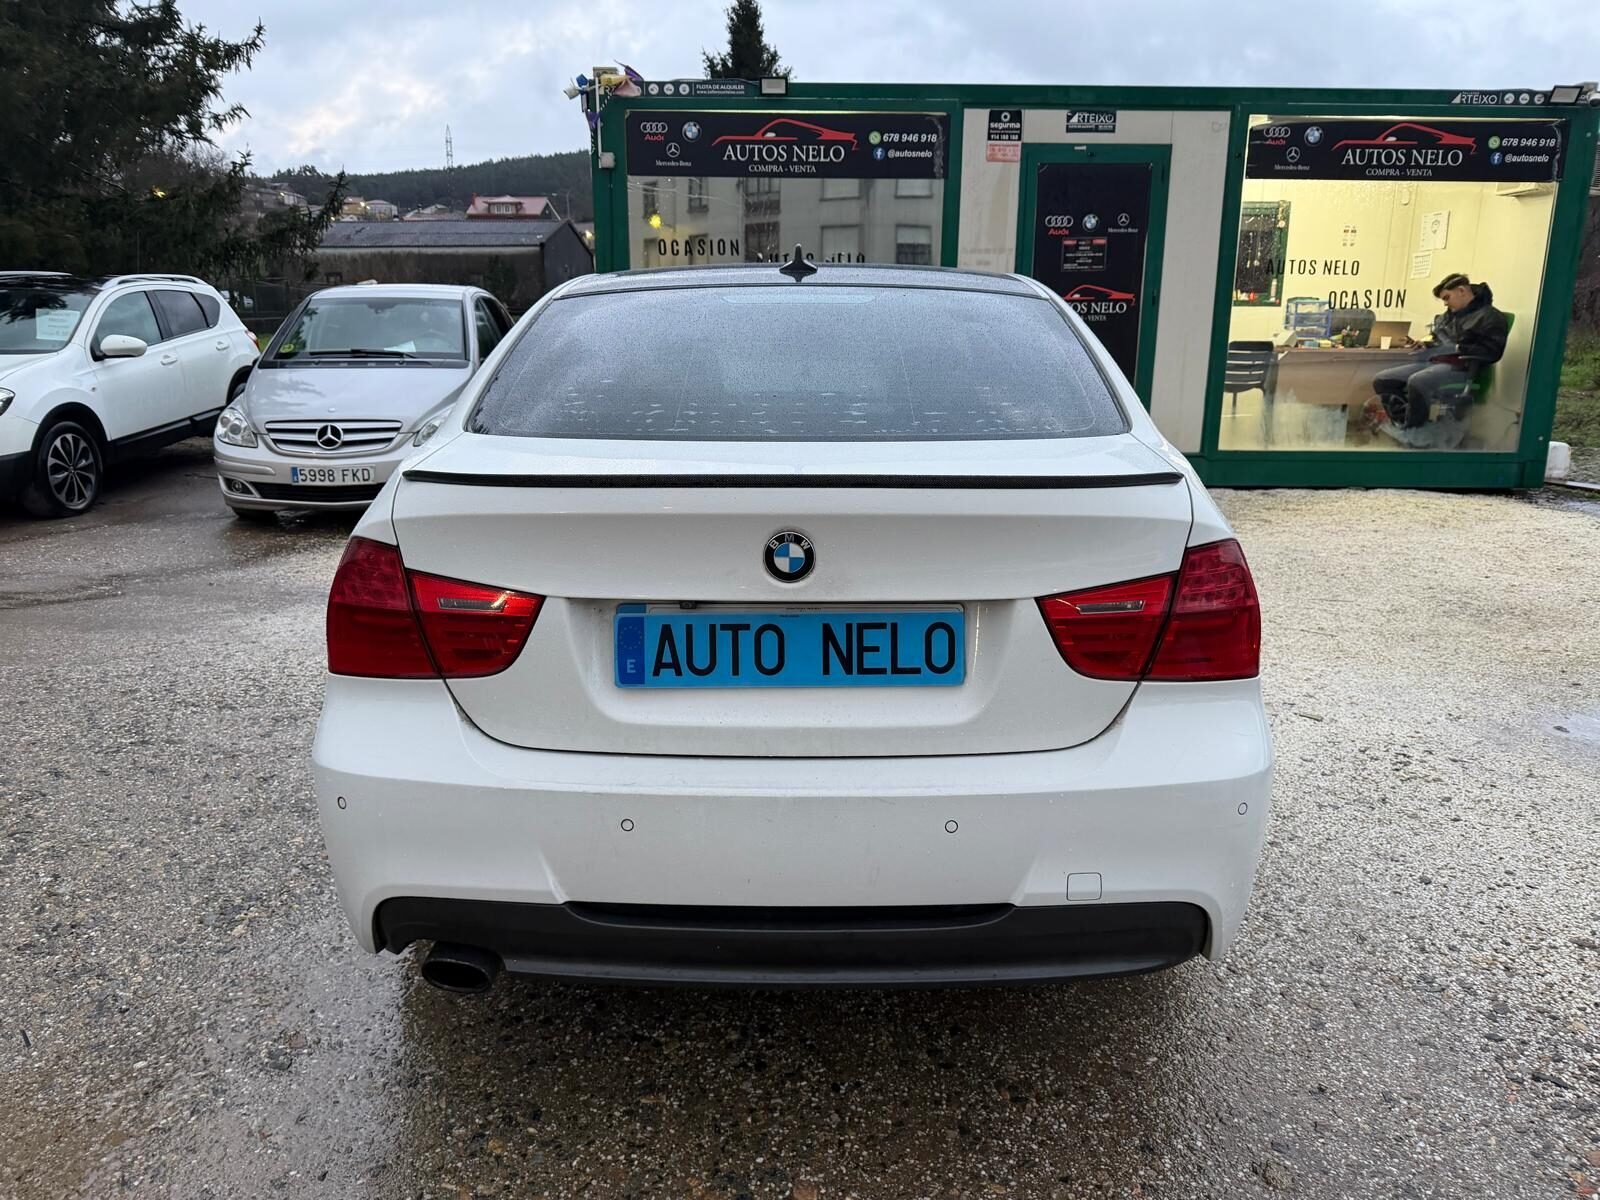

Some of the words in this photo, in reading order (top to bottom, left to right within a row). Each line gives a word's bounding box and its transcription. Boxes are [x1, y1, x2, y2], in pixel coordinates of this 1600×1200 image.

[1451, 92, 1498, 104] ARTEIXO
[1070, 111, 1114, 123] ARTEIXO
[990, 122, 1021, 130] segurma
[882, 132, 900, 143] 678
[901, 132, 919, 143] 946
[920, 133, 938, 143] 918
[1501, 137, 1519, 147] 678
[1520, 137, 1538, 147] 946
[1539, 137, 1557, 147] 918
[723, 144, 787, 162] AUTOS
[792, 144, 845, 163] NELO
[887, 148, 933, 159] @autosnelo
[1341, 148, 1407, 166] AUTOS
[1410, 149, 1463, 166] NELO
[1504, 153, 1550, 163] @autosnelo
[748, 164, 784, 173] COMPRA
[789, 165, 817, 173] VENTA
[1365, 168, 1400, 176] COMPRA
[1406, 168, 1433, 177] VENTA
[1048, 227, 1070, 236] Audi
[658, 238, 740, 257] OCASION
[1265, 259, 1318, 276] AUTOS
[1322, 259, 1360, 276] NELO
[1328, 288, 1407, 310] OCASION
[1090, 302, 1127, 314] NELO
[299, 468, 336, 483] 5998
[341, 468, 371, 483] FKD
[769, 533, 811, 550] BMW
[626, 658, 637, 674] E
[652, 622, 786, 678] AUTO
[822, 621, 956, 676] NELO
